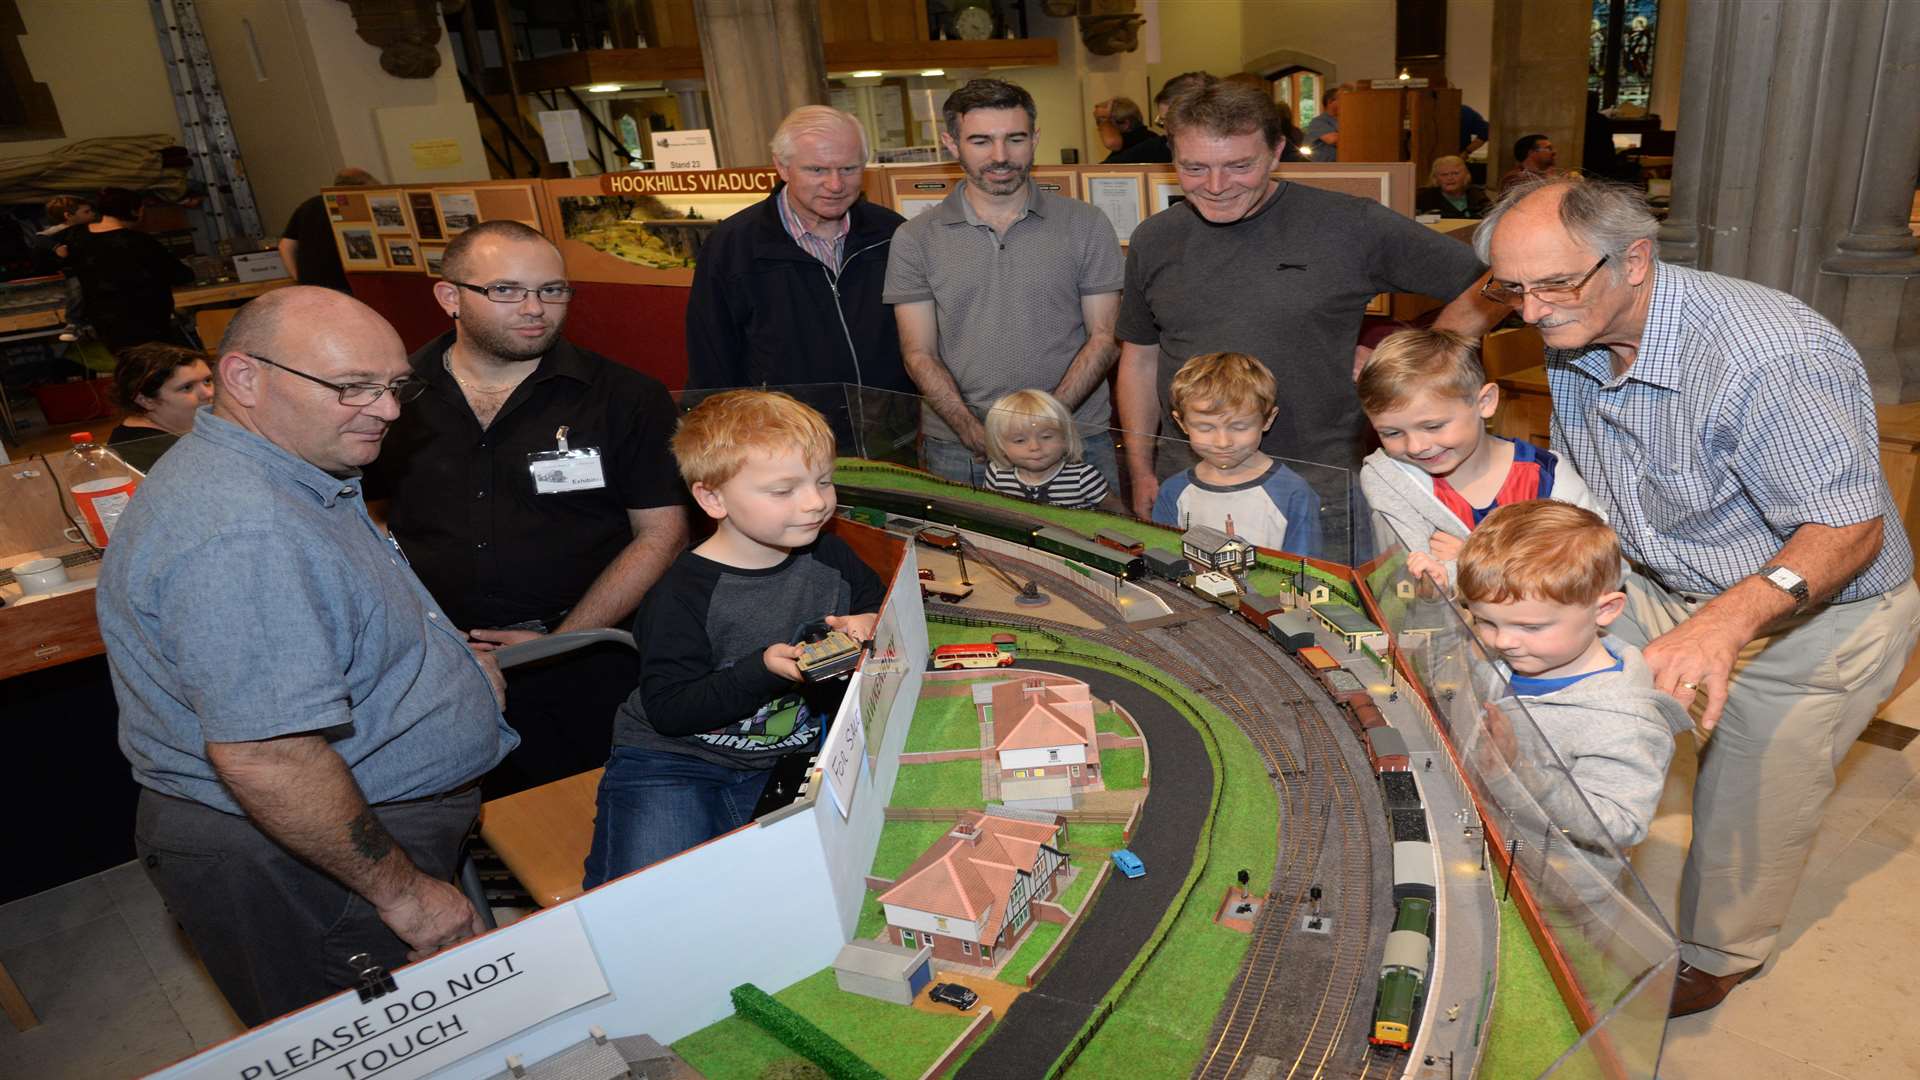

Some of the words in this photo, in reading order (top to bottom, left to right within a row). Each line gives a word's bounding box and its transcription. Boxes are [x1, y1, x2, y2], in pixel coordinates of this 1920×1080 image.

[611, 174, 697, 193] HOOKHILLS
[699, 172, 777, 192] VIADUCT
[670, 160, 691, 169] Stand
[692, 160, 700, 168] 23
[241, 1015, 377, 1080] PLEASE
[384, 989, 437, 1025] DO
[447, 951, 516, 998] NOT
[336, 1014, 464, 1080] TOUCH
